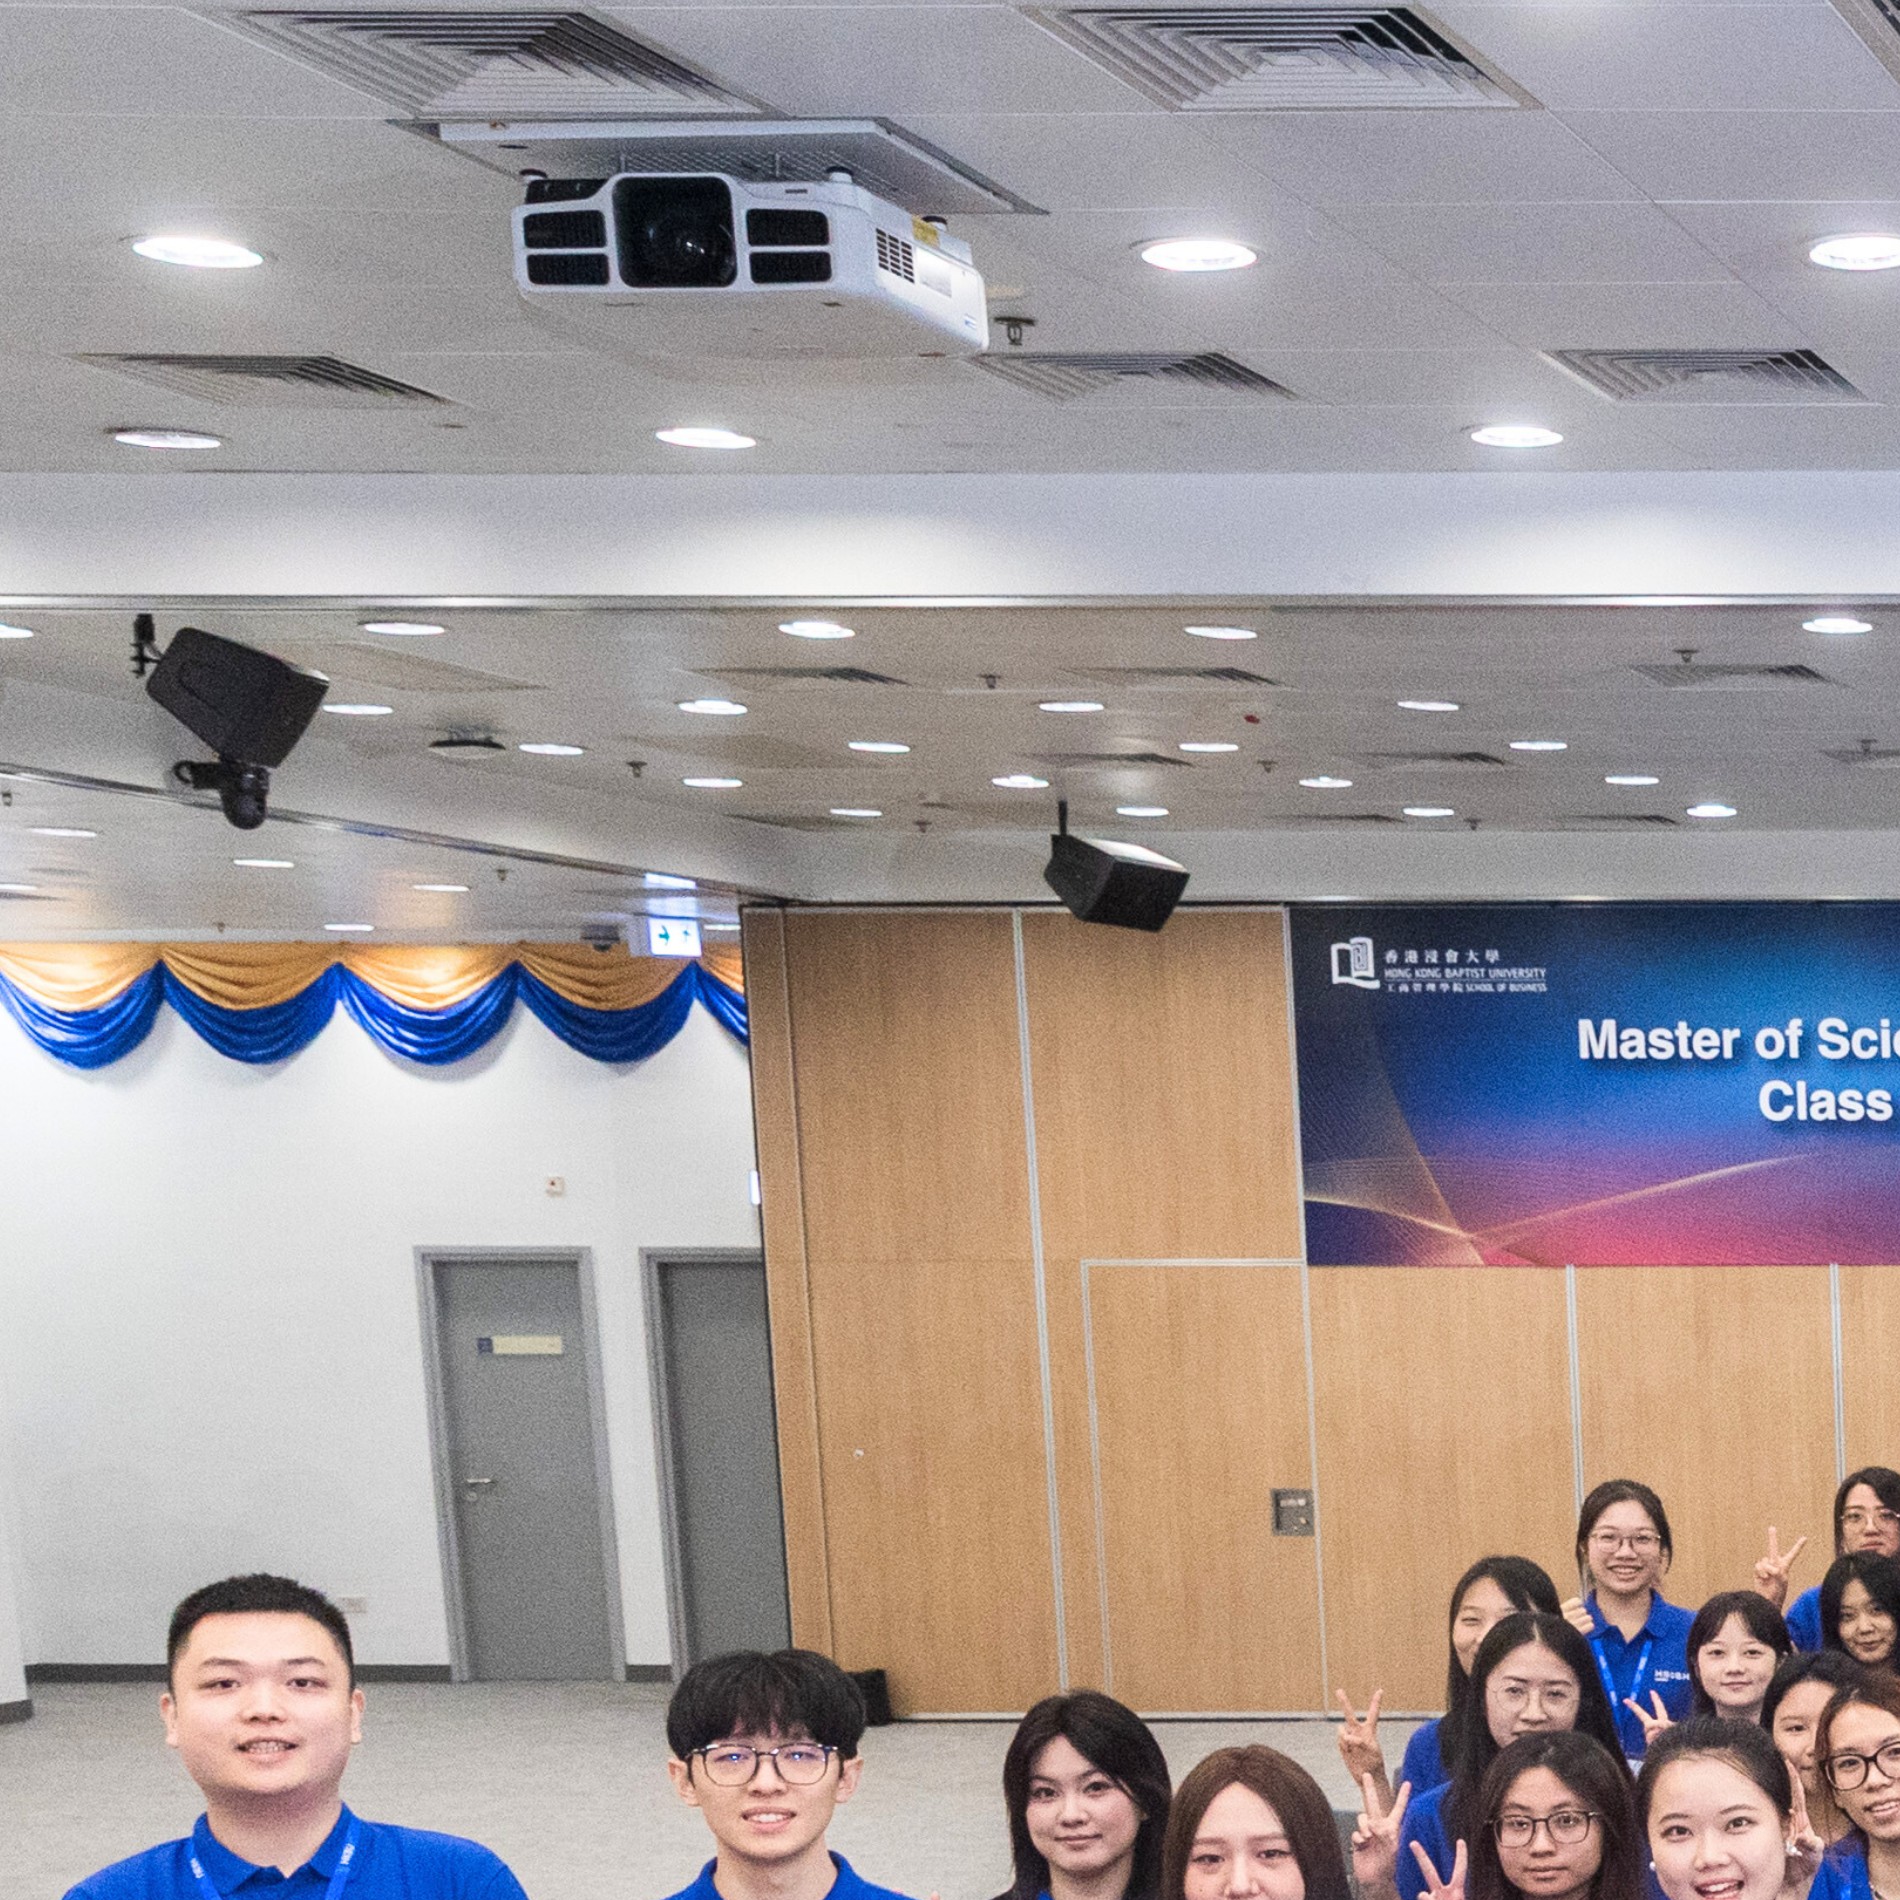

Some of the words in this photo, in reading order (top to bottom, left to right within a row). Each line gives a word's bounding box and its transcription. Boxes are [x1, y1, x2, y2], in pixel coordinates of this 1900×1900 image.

[1384, 949, 1500, 964] 香港浸會大學
[1384, 967, 1412, 980] HONG
[1414, 967, 1442, 980] KONG
[1444, 967, 1486, 980] BAPTIST
[1488, 967, 1547, 980] UNIVERSITY
[1578, 1018, 1741, 1060] Master
[1753, 1018, 1803, 1060] of
[1758, 1079, 1893, 1122] Class
